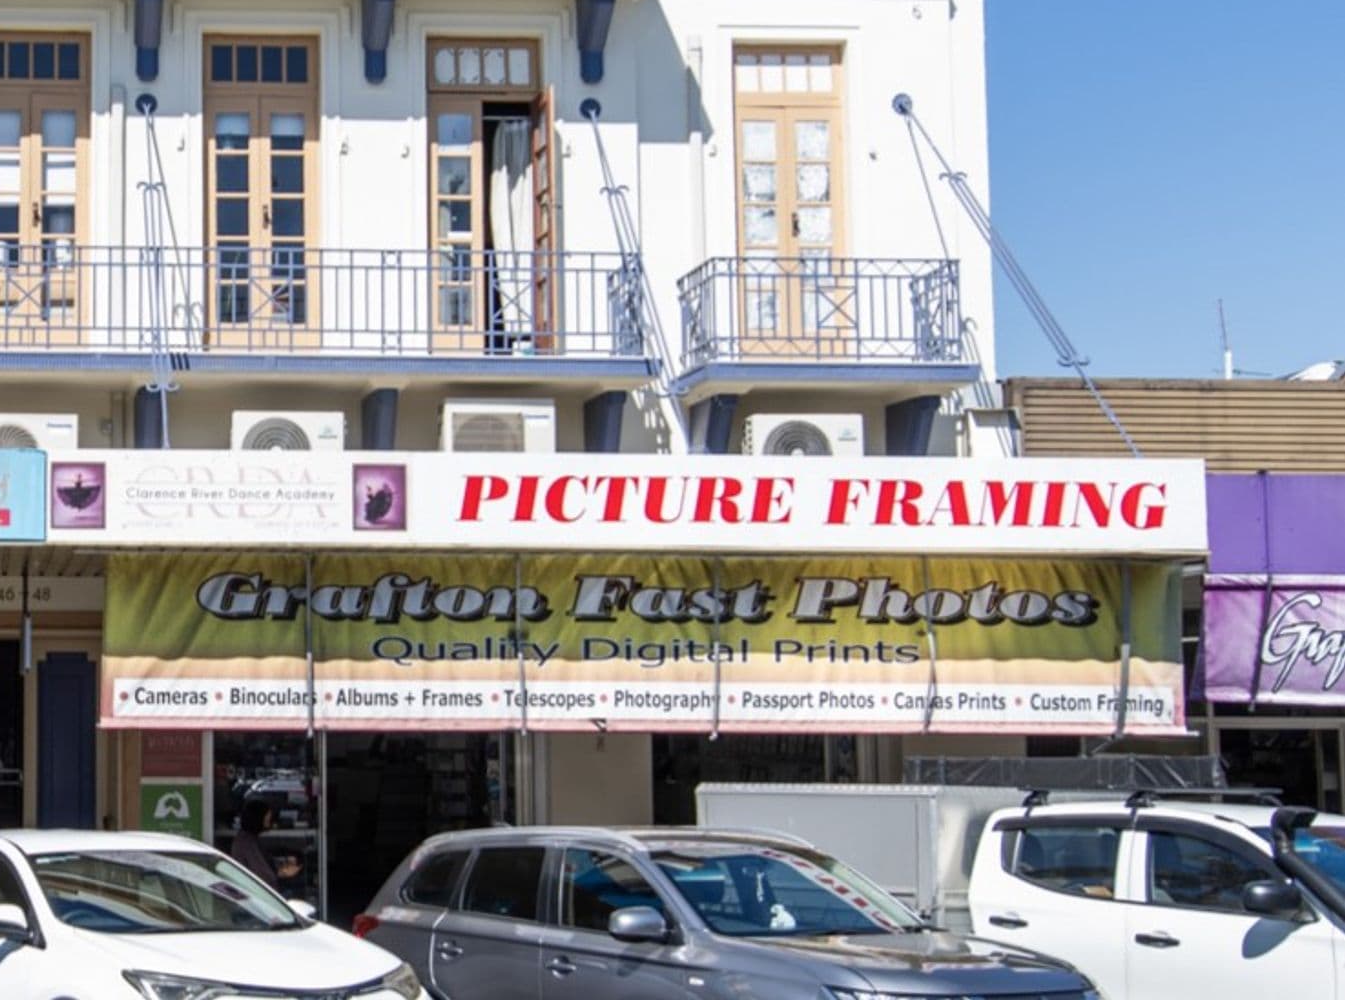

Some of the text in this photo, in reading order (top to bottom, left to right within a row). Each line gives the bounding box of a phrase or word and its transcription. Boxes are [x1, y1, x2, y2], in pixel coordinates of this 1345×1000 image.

[126, 487, 335, 502] Clarence River Dance Academy
[457, 474, 1167, 530] PICTURE FRAMING
[196, 571, 1099, 627] Grafton Fast Photos
[372, 636, 920, 667] Quality Digital Prints
[134, 687, 208, 705] Cameras
[230, 688, 317, 706] Binoculars
[335, 688, 399, 707] Albums
[405, 692, 415, 706] +
[422, 689, 483, 707] Frames
[504, 689, 595, 711] Telescopes
[742, 691, 813, 711] Passport
[819, 691, 874, 709] Photos
[958, 692, 1006, 710] Prints
[1030, 693, 1092, 711] Custom
